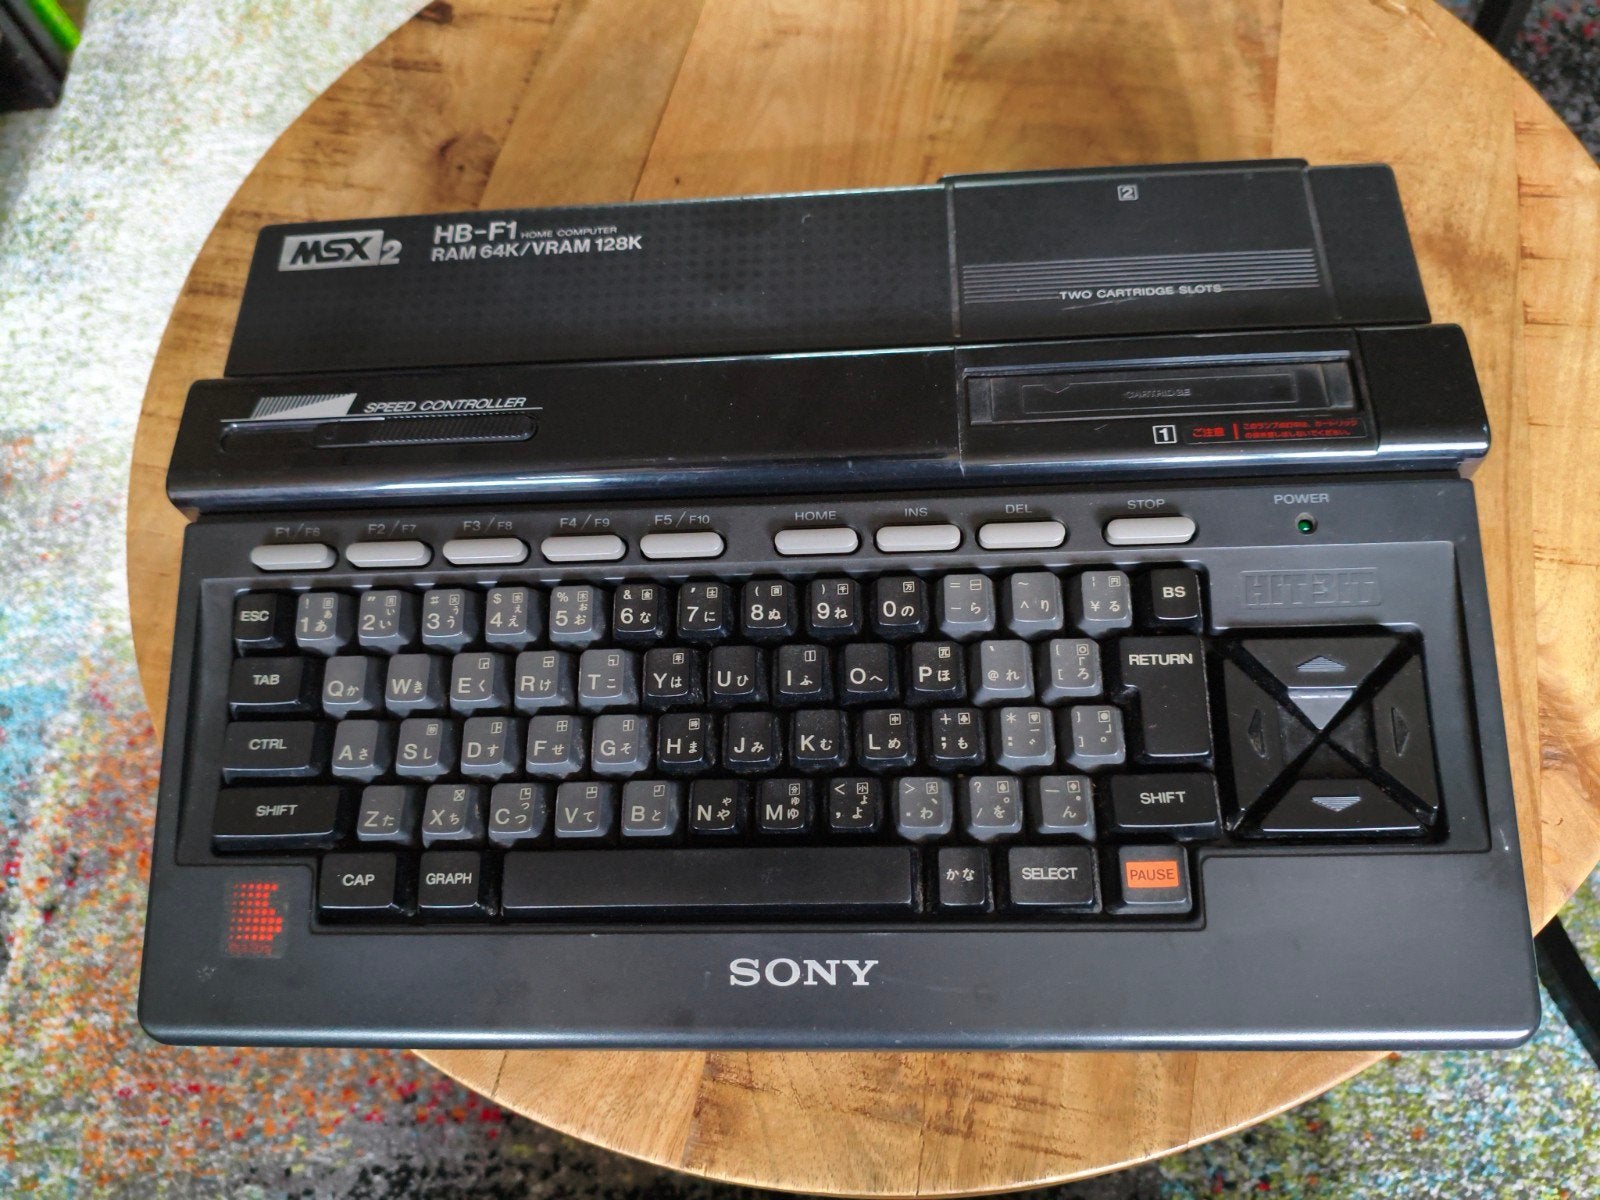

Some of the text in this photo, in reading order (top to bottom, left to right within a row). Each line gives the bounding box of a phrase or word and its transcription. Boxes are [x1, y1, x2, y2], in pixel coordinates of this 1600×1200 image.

[434, 221, 618, 244] HB-F1 HOME COMPUTER
[431, 246, 477, 262] RAM
[595, 235, 642, 253] 128K
[1059, 283, 1222, 300] TWO CARTRIDGE SLOTS
[364, 397, 526, 414] SPEED CONTROLLER
[1127, 498, 1167, 510] STOP
[1273, 492, 1330, 505] POWER
[904, 507, 929, 518] INS
[1005, 503, 1033, 514] DEL
[794, 510, 837, 522] HOME
[493, 593, 502, 604] $
[557, 592, 569, 602] %
[623, 589, 632, 600] &
[1162, 586, 1186, 598] BS
[817, 602, 830, 619] 9
[901, 605, 915, 617] の
[970, 602, 981, 615] ら
[1040, 599, 1050, 612] り
[1109, 600, 1120, 612] る
[240, 610, 269, 623] ESC
[555, 610, 568, 626] 5
[620, 607, 634, 624] 6
[640, 611, 652, 624] な
[687, 606, 699, 623] 7
[703, 611, 716, 623] に
[751, 604, 764, 621] 8
[768, 608, 781, 620] ぬ
[834, 607, 848, 619] ね
[301, 617, 309, 632] 1
[315, 620, 327, 632] あ
[362, 614, 376, 630] 2
[380, 620, 392, 629] い
[426, 613, 440, 629] 3
[446, 616, 456, 628] う
[489, 612, 503, 627] 4
[508, 615, 519, 627] え
[573, 614, 587, 625] お
[1128, 652, 1194, 667] RETURN
[253, 674, 280, 686] TAB
[717, 670, 731, 687] U
[787, 670, 792, 686] I
[850, 667, 866, 685] O
[919, 666, 933, 683] P
[938, 669, 951, 682] ほ
[987, 670, 999, 682] @
[1006, 669, 1020, 681] れ
[1077, 667, 1089, 680] ろ
[392, 678, 412, 694] W
[413, 680, 423, 694] き
[458, 677, 472, 693] E
[479, 679, 486, 692] く
[520, 675, 535, 691] R
[540, 679, 552, 691] け
[588, 674, 601, 690] T
[606, 678, 616, 689] こ
[653, 673, 667, 689] Y
[670, 676, 682, 688] は
[737, 674, 749, 687] ひ
[800, 675, 813, 686] ふ
[327, 680, 344, 697] Q
[346, 685, 359, 696] か
[248, 738, 288, 751] CTRL
[534, 740, 548, 756] F
[600, 739, 616, 756] G
[620, 742, 632, 755] そ
[666, 738, 682, 754] H
[688, 741, 698, 754] ま
[734, 737, 745, 754] J
[751, 742, 764, 753] み
[801, 734, 816, 752] K
[820, 738, 833, 751] む
[868, 734, 881, 750] L
[888, 737, 901, 749] め
[958, 737, 968, 749] も
[338, 745, 353, 760] A
[359, 747, 368, 760] さ
[403, 743, 418, 760] S
[423, 747, 433, 759] し
[467, 742, 482, 758] D
[487, 744, 499, 757] す
[552, 744, 565, 755] せ
[973, 781, 982, 793] ?
[1139, 791, 1186, 805] SHIFT
[256, 804, 299, 817] SHIFT
[495, 808, 510, 825] C
[565, 807, 579, 824] V
[583, 811, 595, 823] て
[631, 805, 645, 822] B
[652, 809, 662, 821] と
[697, 804, 712, 821] N
[717, 809, 731, 821] や
[766, 804, 783, 821] M
[787, 808, 799, 820] ゆ
[852, 807, 863, 819] よ
[920, 807, 933, 820] わ
[993, 805, 1006, 819] を
[1062, 806, 1077, 819] ん
[364, 811, 380, 827] Z
[382, 814, 395, 827] た
[429, 809, 445, 826] X
[450, 812, 460, 825] ち
[515, 814, 527, 824] つ
[342, 873, 375, 887] CAP
[425, 872, 473, 885] GRAPH
[946, 867, 975, 882] かな
[1022, 867, 1078, 880] SELECT
[1129, 867, 1176, 882] PAUSE
[729, 957, 879, 987] SONY
